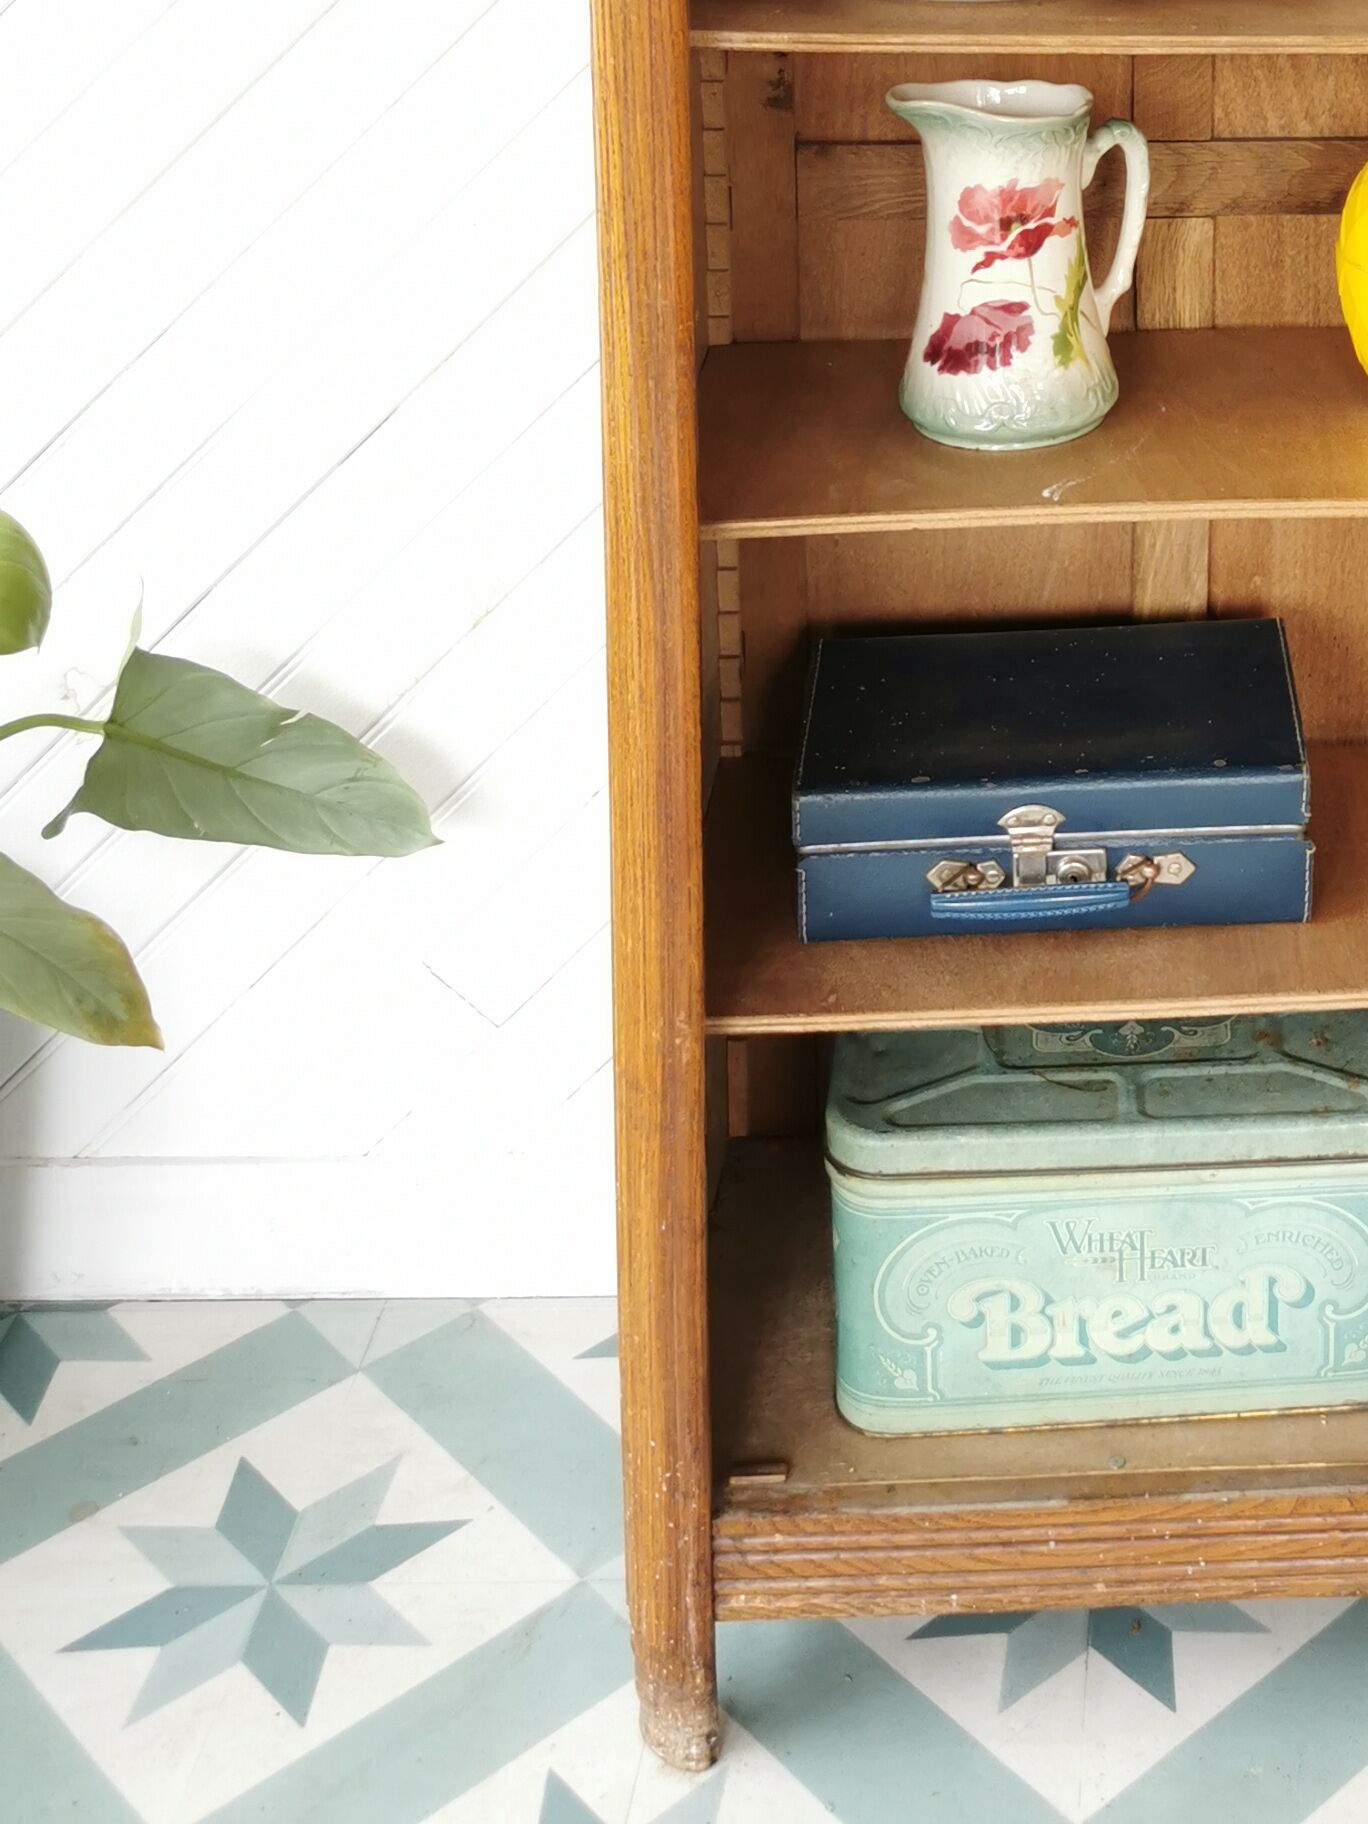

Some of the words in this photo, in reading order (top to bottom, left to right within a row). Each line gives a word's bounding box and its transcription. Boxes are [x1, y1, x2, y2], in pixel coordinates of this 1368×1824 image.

[915, 1245, 1011, 1297] OVEN-BAKED
[1253, 1230, 1344, 1272] ENRICHED
[946, 1263, 1315, 1370] Bread
